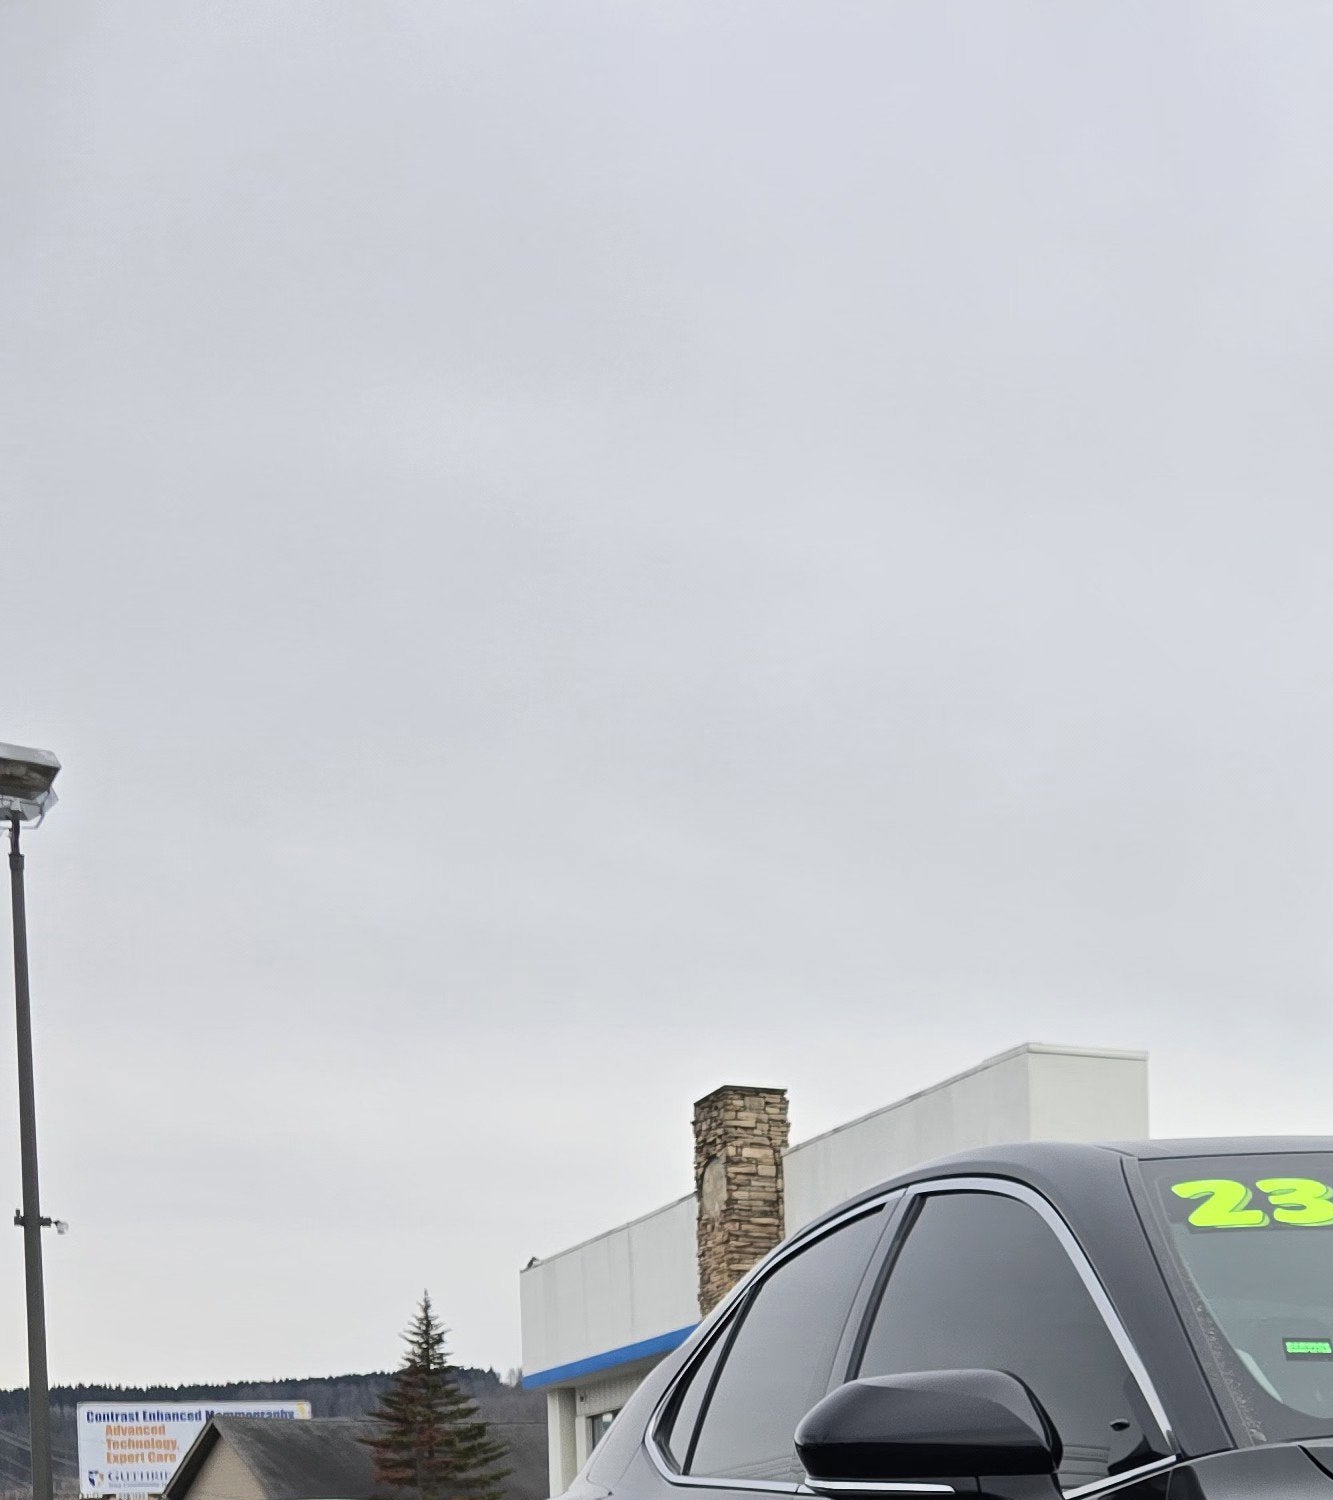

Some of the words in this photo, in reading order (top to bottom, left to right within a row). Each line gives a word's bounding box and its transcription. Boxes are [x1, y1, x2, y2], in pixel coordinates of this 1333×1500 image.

[86, 1410, 139, 1424] Contrast
[142, 1409, 202, 1423] Enhanced
[105, 1424, 166, 1437] Advanced
[106, 1451, 145, 1465] Expert
[147, 1451, 177, 1464] Care
